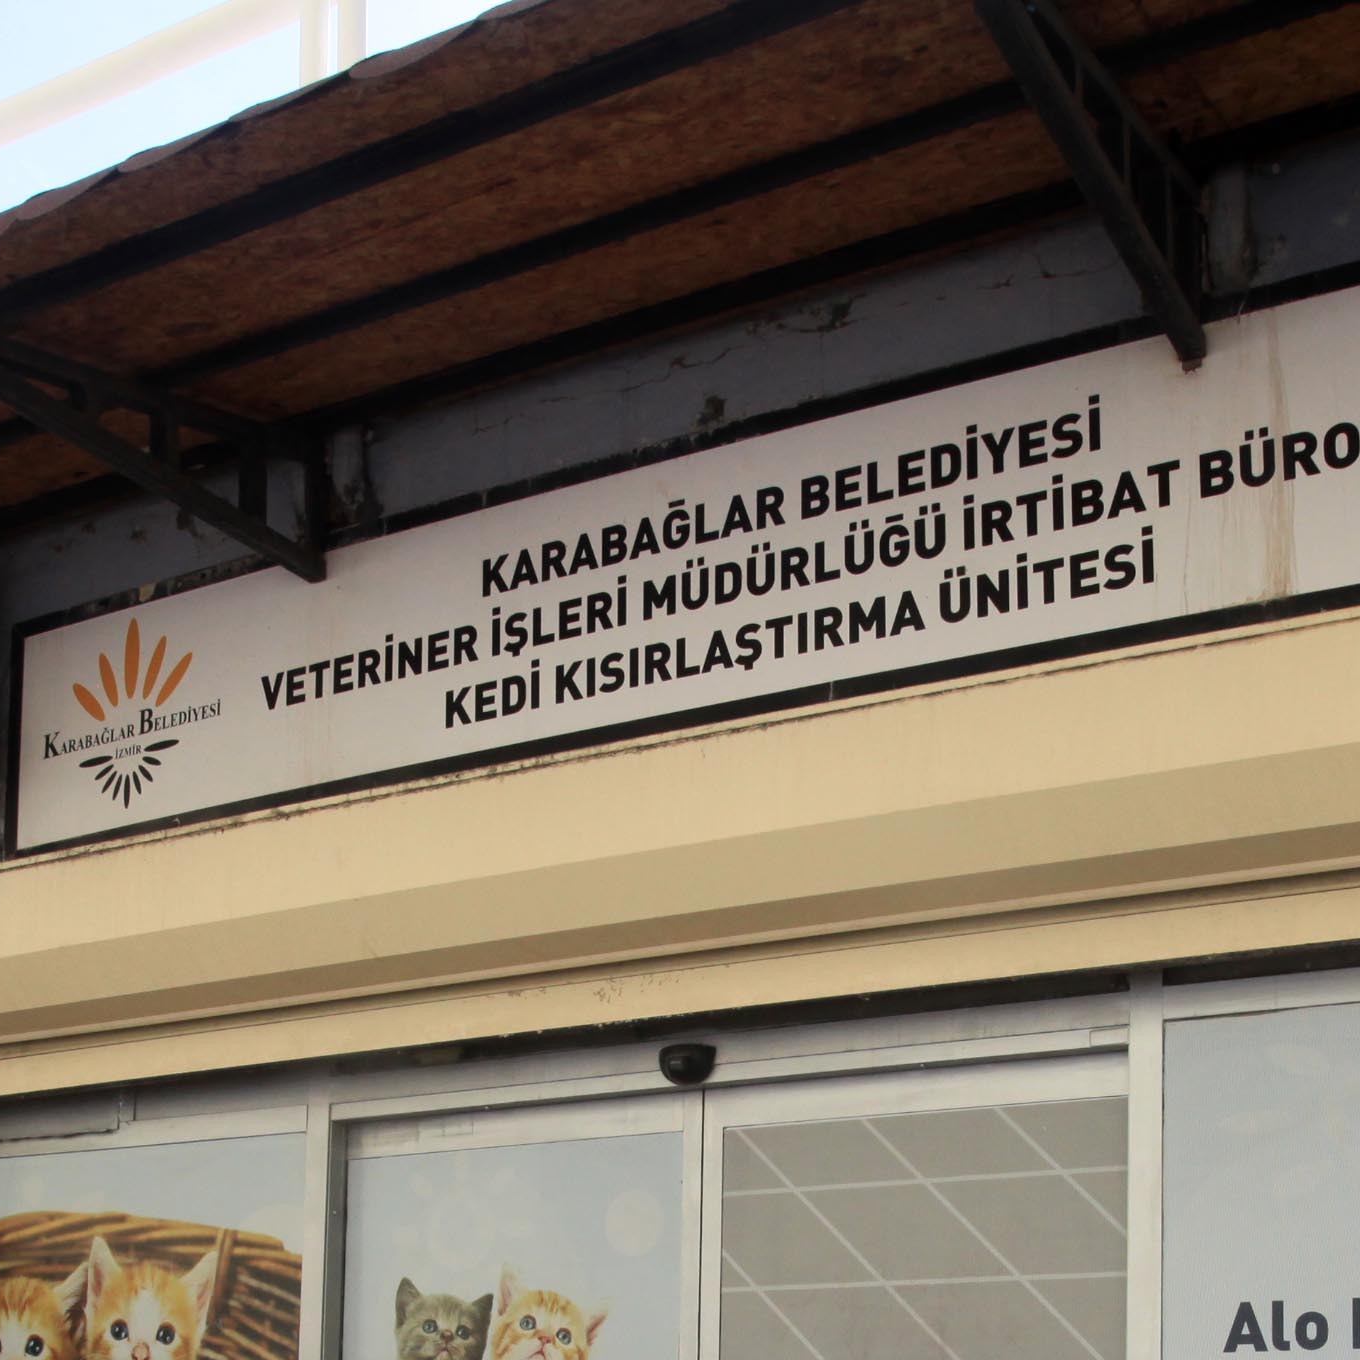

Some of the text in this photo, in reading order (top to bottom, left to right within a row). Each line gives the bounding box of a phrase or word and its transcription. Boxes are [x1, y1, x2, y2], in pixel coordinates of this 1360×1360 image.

[482, 394, 1102, 597] KARABAĞLAR BELEDİYESİ
[261, 624, 478, 710] VETERİNER
[491, 575, 627, 656] İŞLERİ
[643, 503, 946, 621] MÜDÜRLÜĞÜ
[963, 460, 1180, 551] İRTİBAT
[445, 526, 1154, 729] KEDİ KISIRLAŞTIRMA ÜNİTESİ
[43, 699, 221, 759] KARABAĞLAR BELEDİYESİ
[115, 744, 142, 759] İZMİR
[1223, 1300, 1329, 1353] Alo
